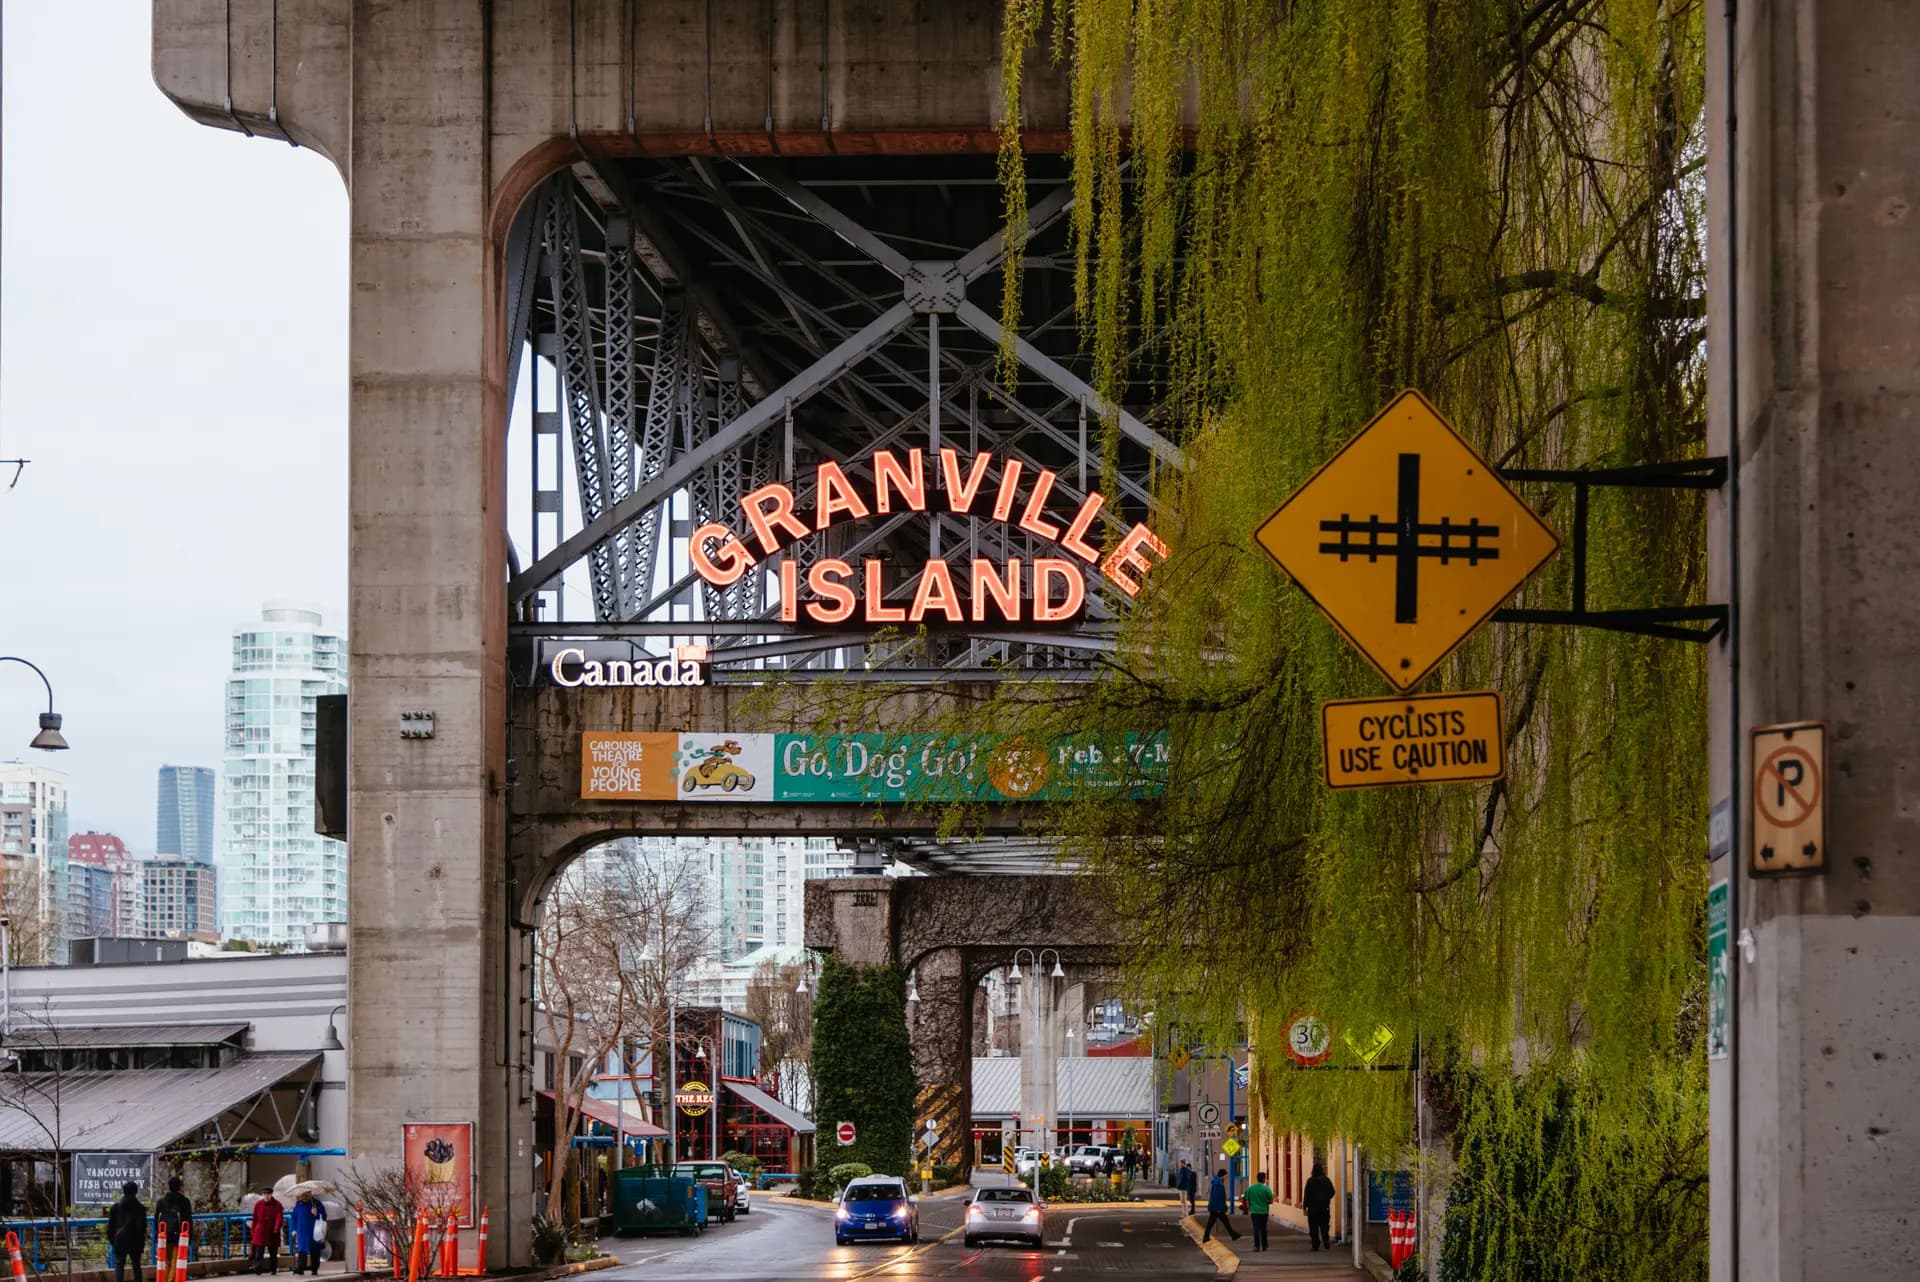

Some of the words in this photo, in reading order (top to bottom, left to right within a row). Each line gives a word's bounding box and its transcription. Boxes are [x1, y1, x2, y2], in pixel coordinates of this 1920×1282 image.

[689, 447, 1172, 598] GRANVILLE
[779, 558, 1085, 625] ISLAND
[551, 648, 705, 687] Canada
[1359, 710, 1465, 741] CYCLISTS
[590, 741, 643, 751] CAROUSEL
[592, 750, 643, 761] THEATRE
[1340, 746, 1382, 773] USE
[1393, 739, 1487, 769] CAUTION
[784, 740, 833, 780] Go,
[841, 741, 912, 788] Dog.
[920, 739, 978, 780] Go!
[592, 767, 640, 779] YOUNG
[590, 778, 641, 792] PEOPLE
[675, 1094, 695, 1103] THE
[86, 1167, 141, 1177] VANCOUVER
[79, 1180, 100, 1189] FISH
[102, 1180, 145, 1189] COMPY
